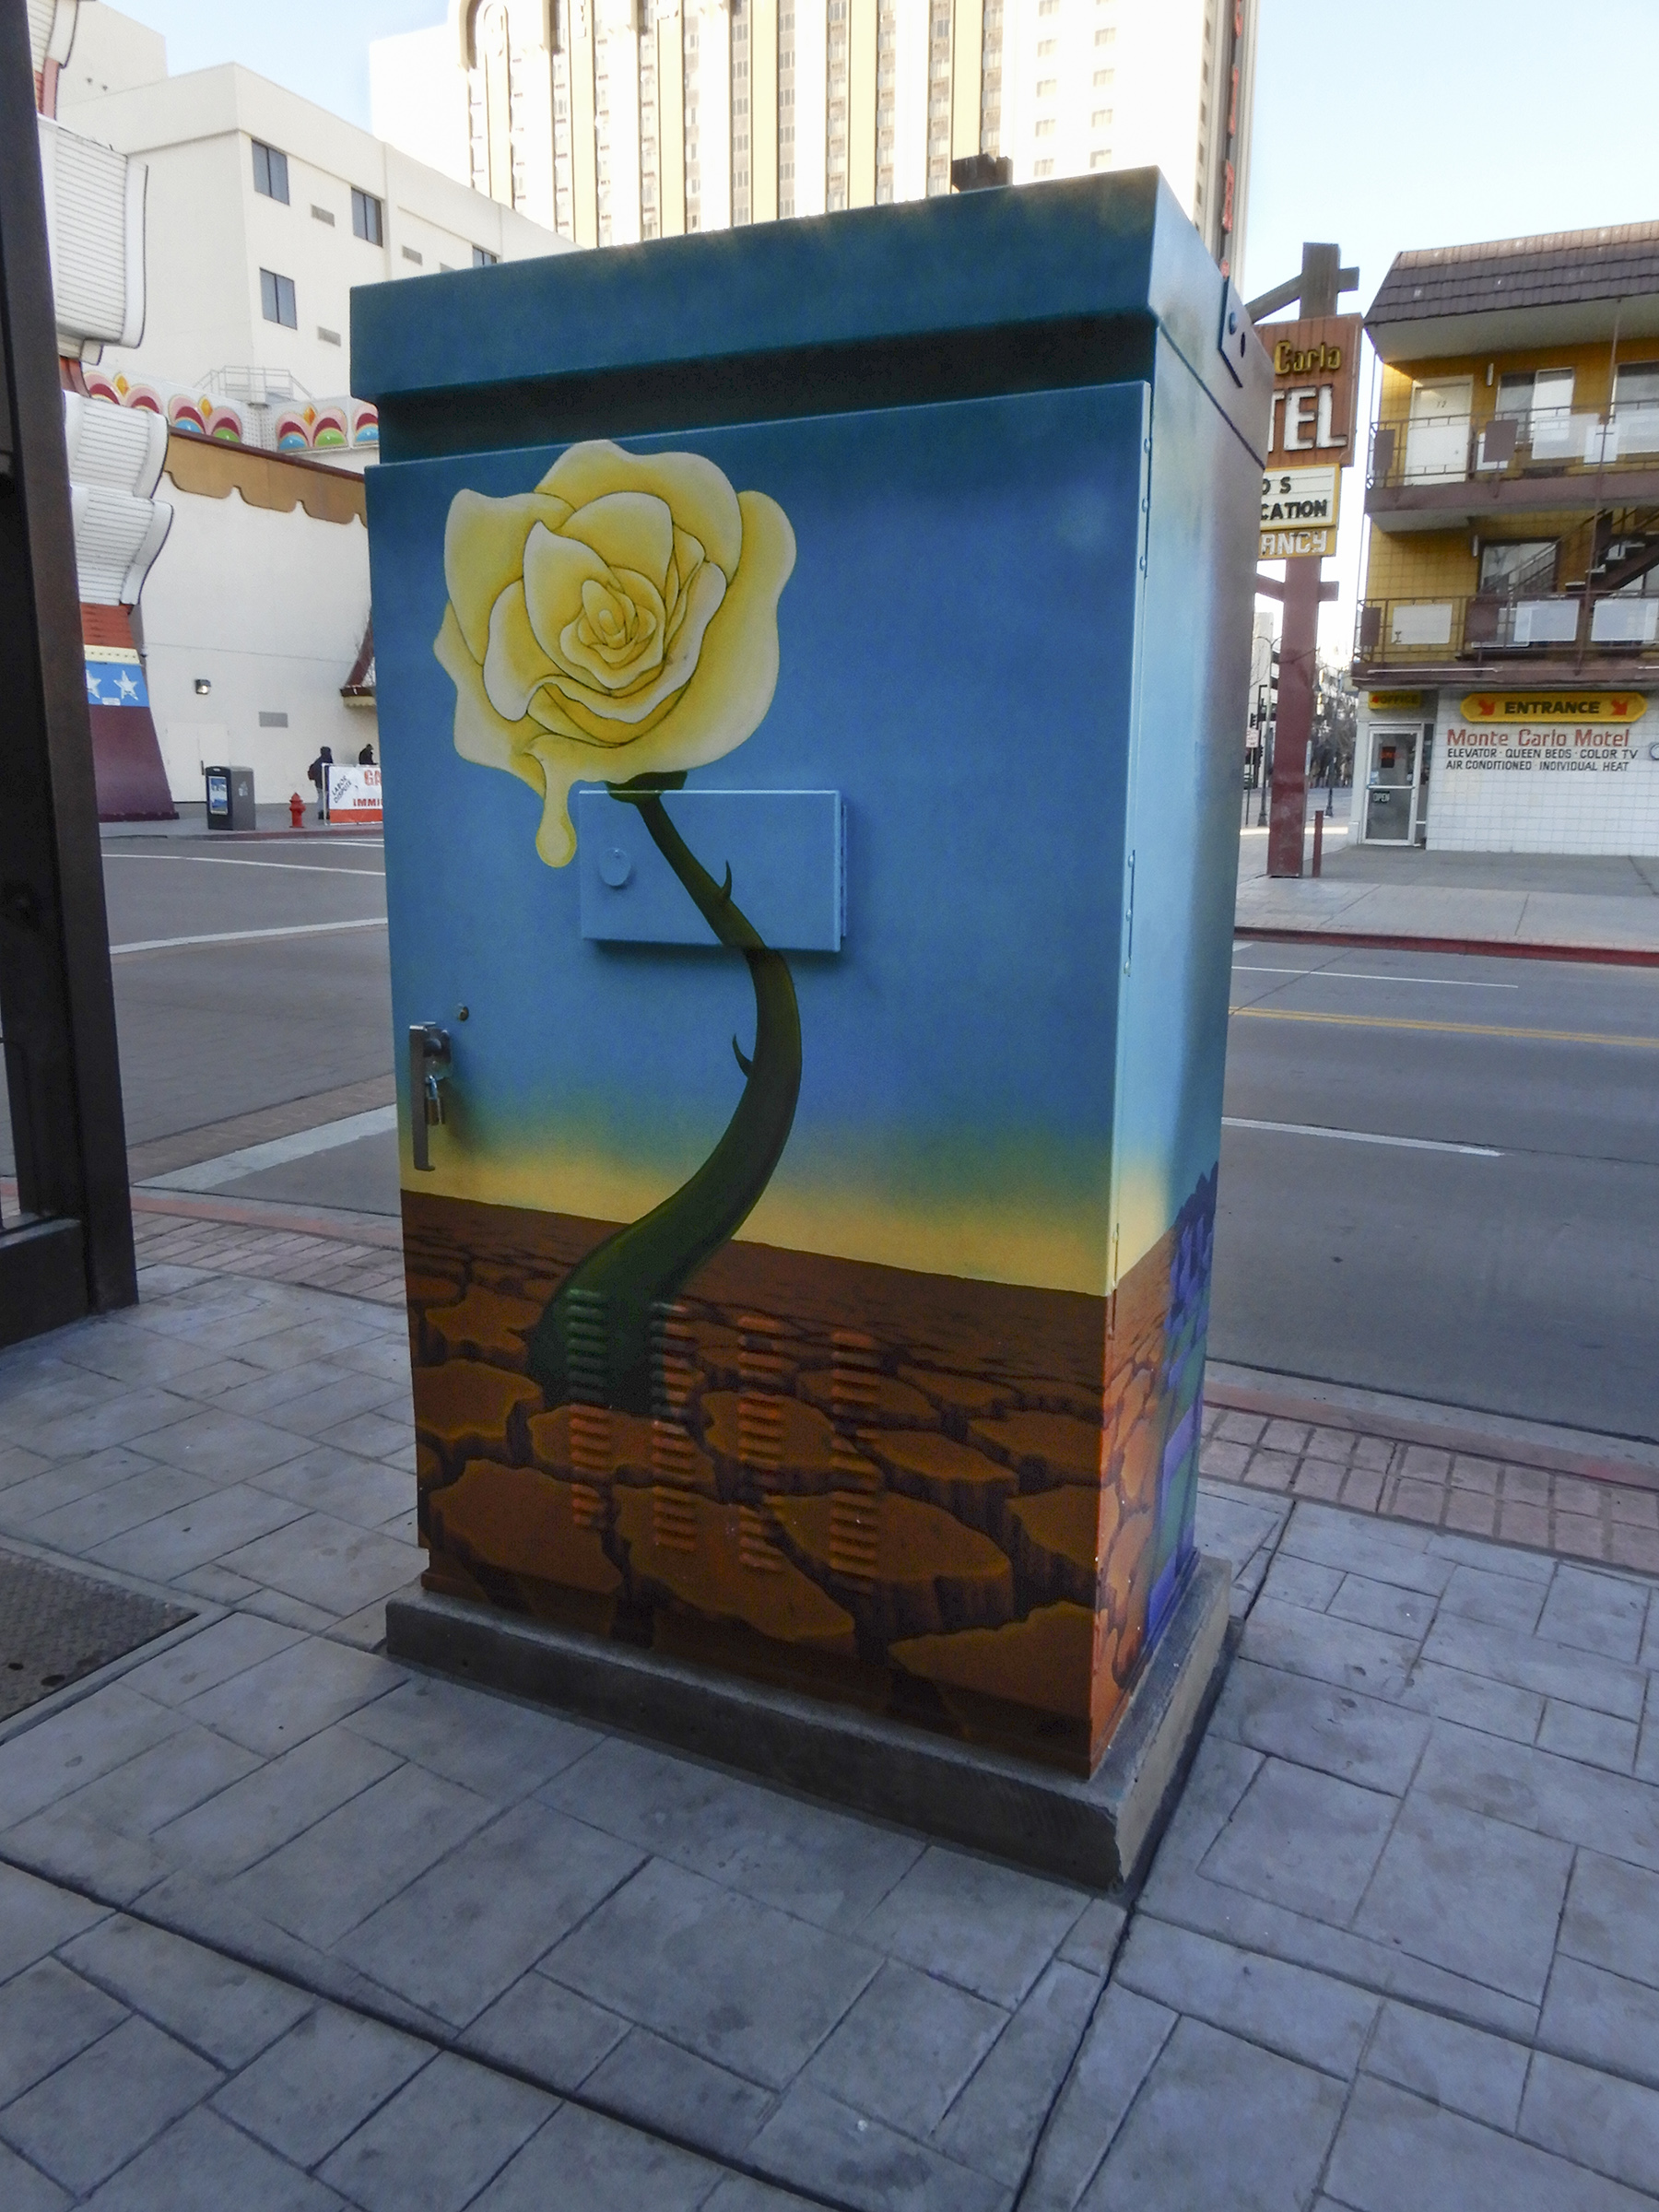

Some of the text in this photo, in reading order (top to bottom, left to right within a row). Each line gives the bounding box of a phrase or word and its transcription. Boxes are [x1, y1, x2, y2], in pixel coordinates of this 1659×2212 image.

[1274, 340, 1342, 375] Carlo
[1504, 700, 1602, 714] ENTRANCE
[1447, 728, 1630, 747] Monte Carlo Motel
[1447, 747, 1639, 759] ELEVATOR QUEEN BEDS COLOR TV
[1446, 760, 1630, 771] AIR CONDITIONED INDIVIDUAL HEAT
